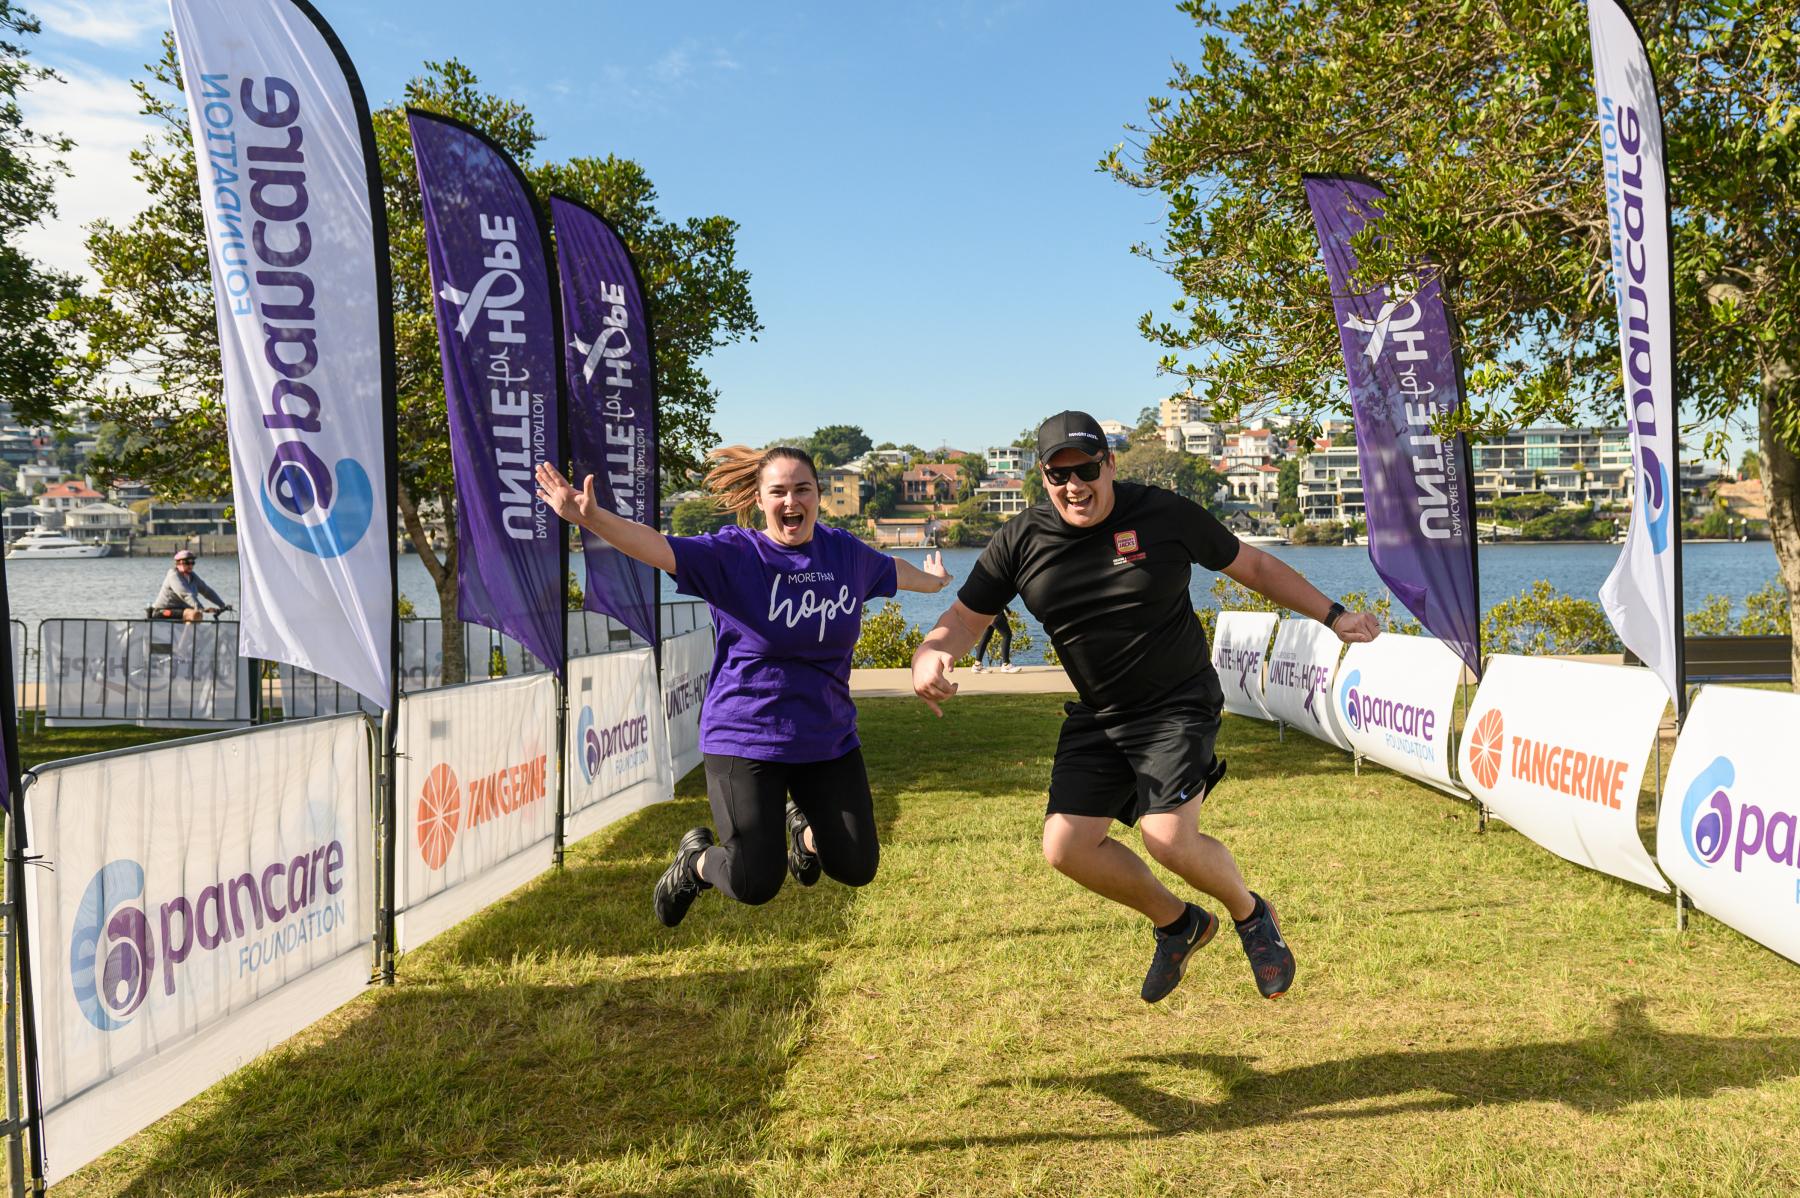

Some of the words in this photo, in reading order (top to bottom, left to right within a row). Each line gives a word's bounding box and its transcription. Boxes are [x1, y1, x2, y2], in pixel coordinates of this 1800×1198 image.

[788, 572, 816, 584] MORE
[816, 571, 835, 582] THAN
[768, 573, 856, 642] hope
[665, 682, 689, 720] UNITE
[1270, 659, 1296, 687] UNITE
[1302, 664, 1328, 705] HOPE
[599, 714, 648, 770] pancare
[1362, 694, 1435, 741] pancare
[1386, 733, 1435, 762] FOUNDATION
[1511, 735, 1629, 810] TANGERINE
[466, 755, 547, 830] TANGERINE
[160, 839, 344, 996] pancare
[239, 899, 345, 979] FOUNDATION
